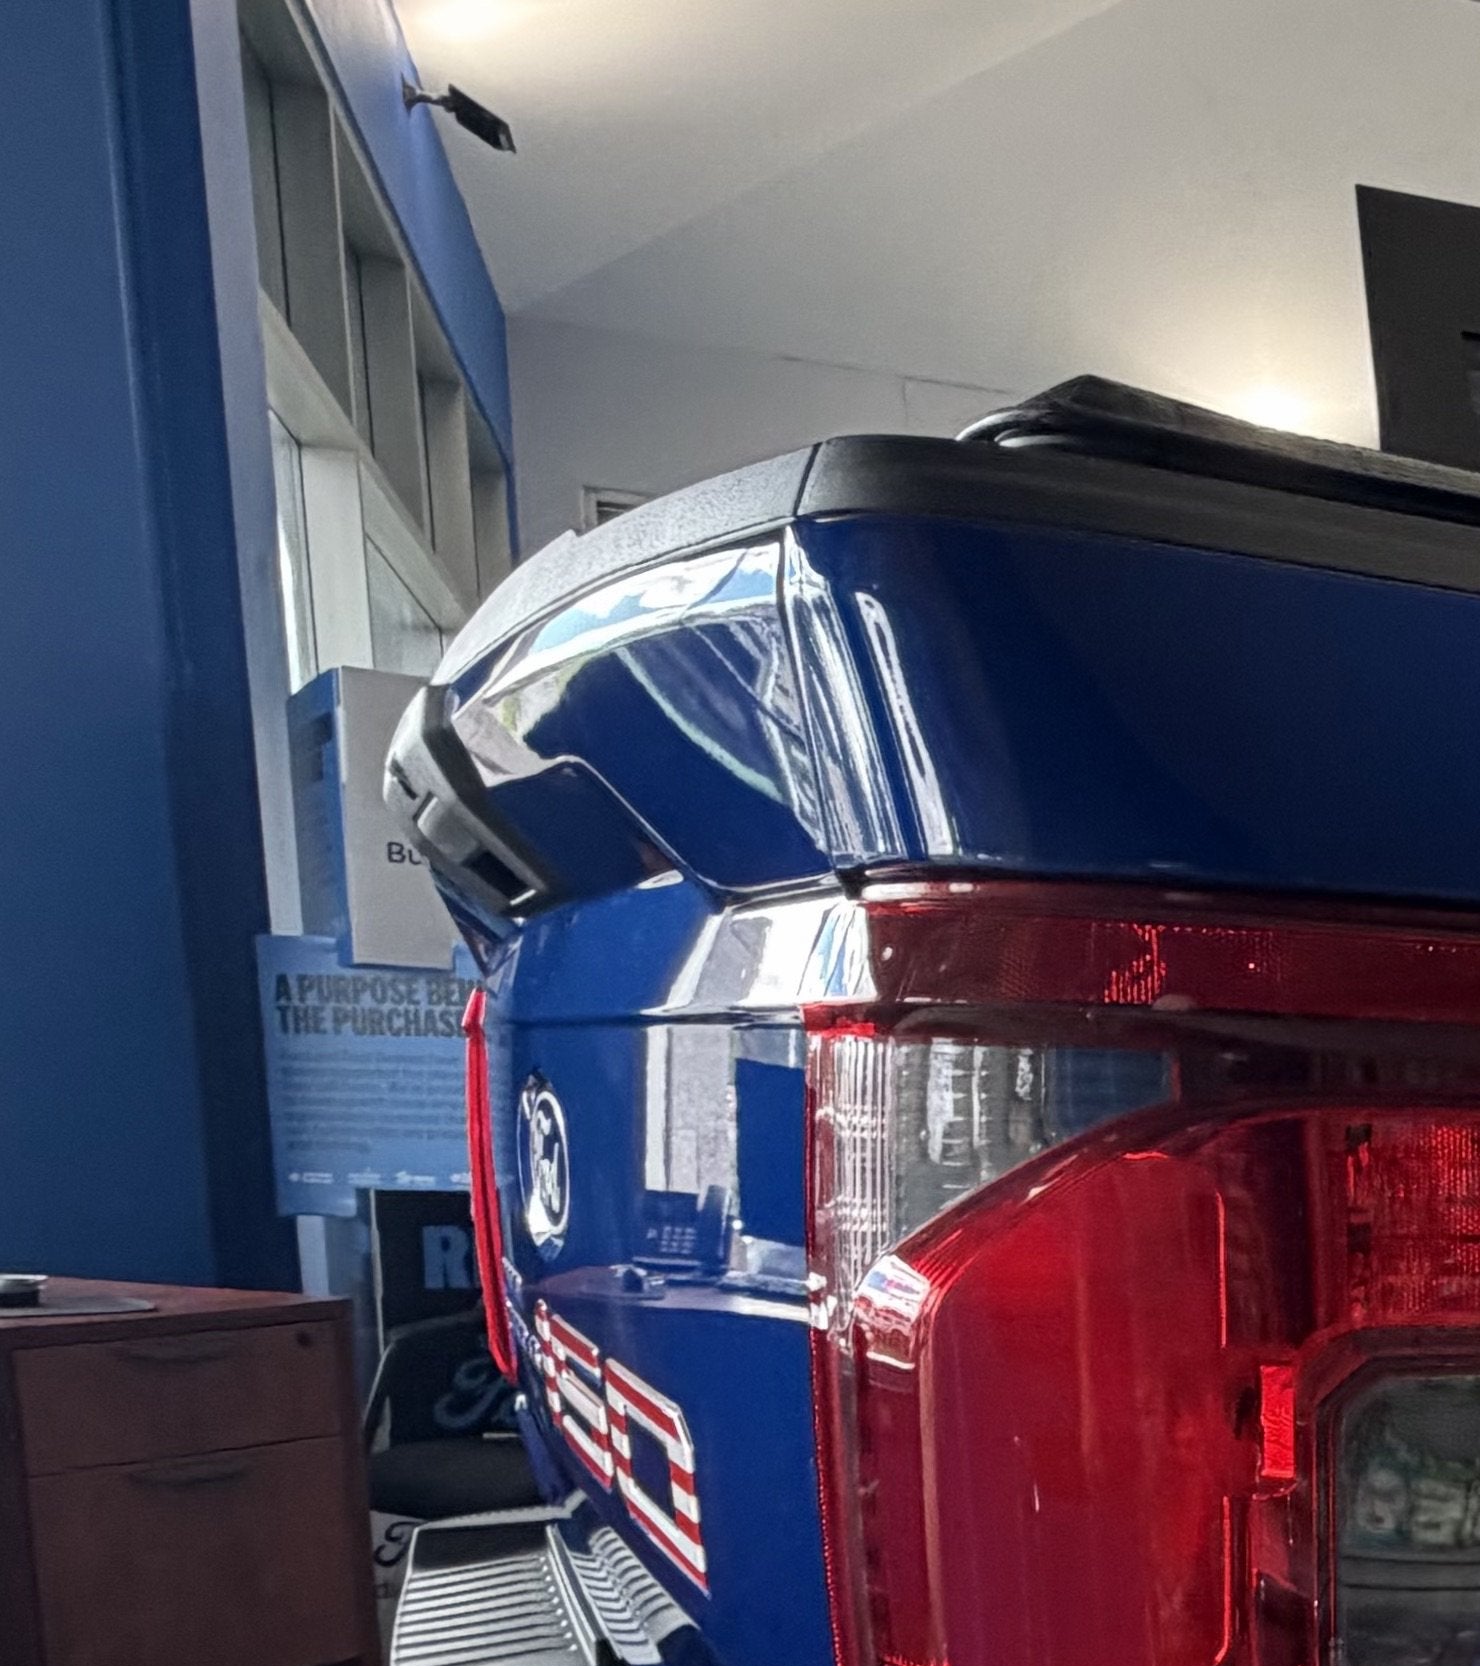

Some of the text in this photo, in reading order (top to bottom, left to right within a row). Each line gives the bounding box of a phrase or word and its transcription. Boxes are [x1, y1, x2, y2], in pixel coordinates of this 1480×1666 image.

[275, 973, 293, 1004] A
[296, 974, 421, 1006] PURPOSE
[275, 1005, 328, 1035] THE
